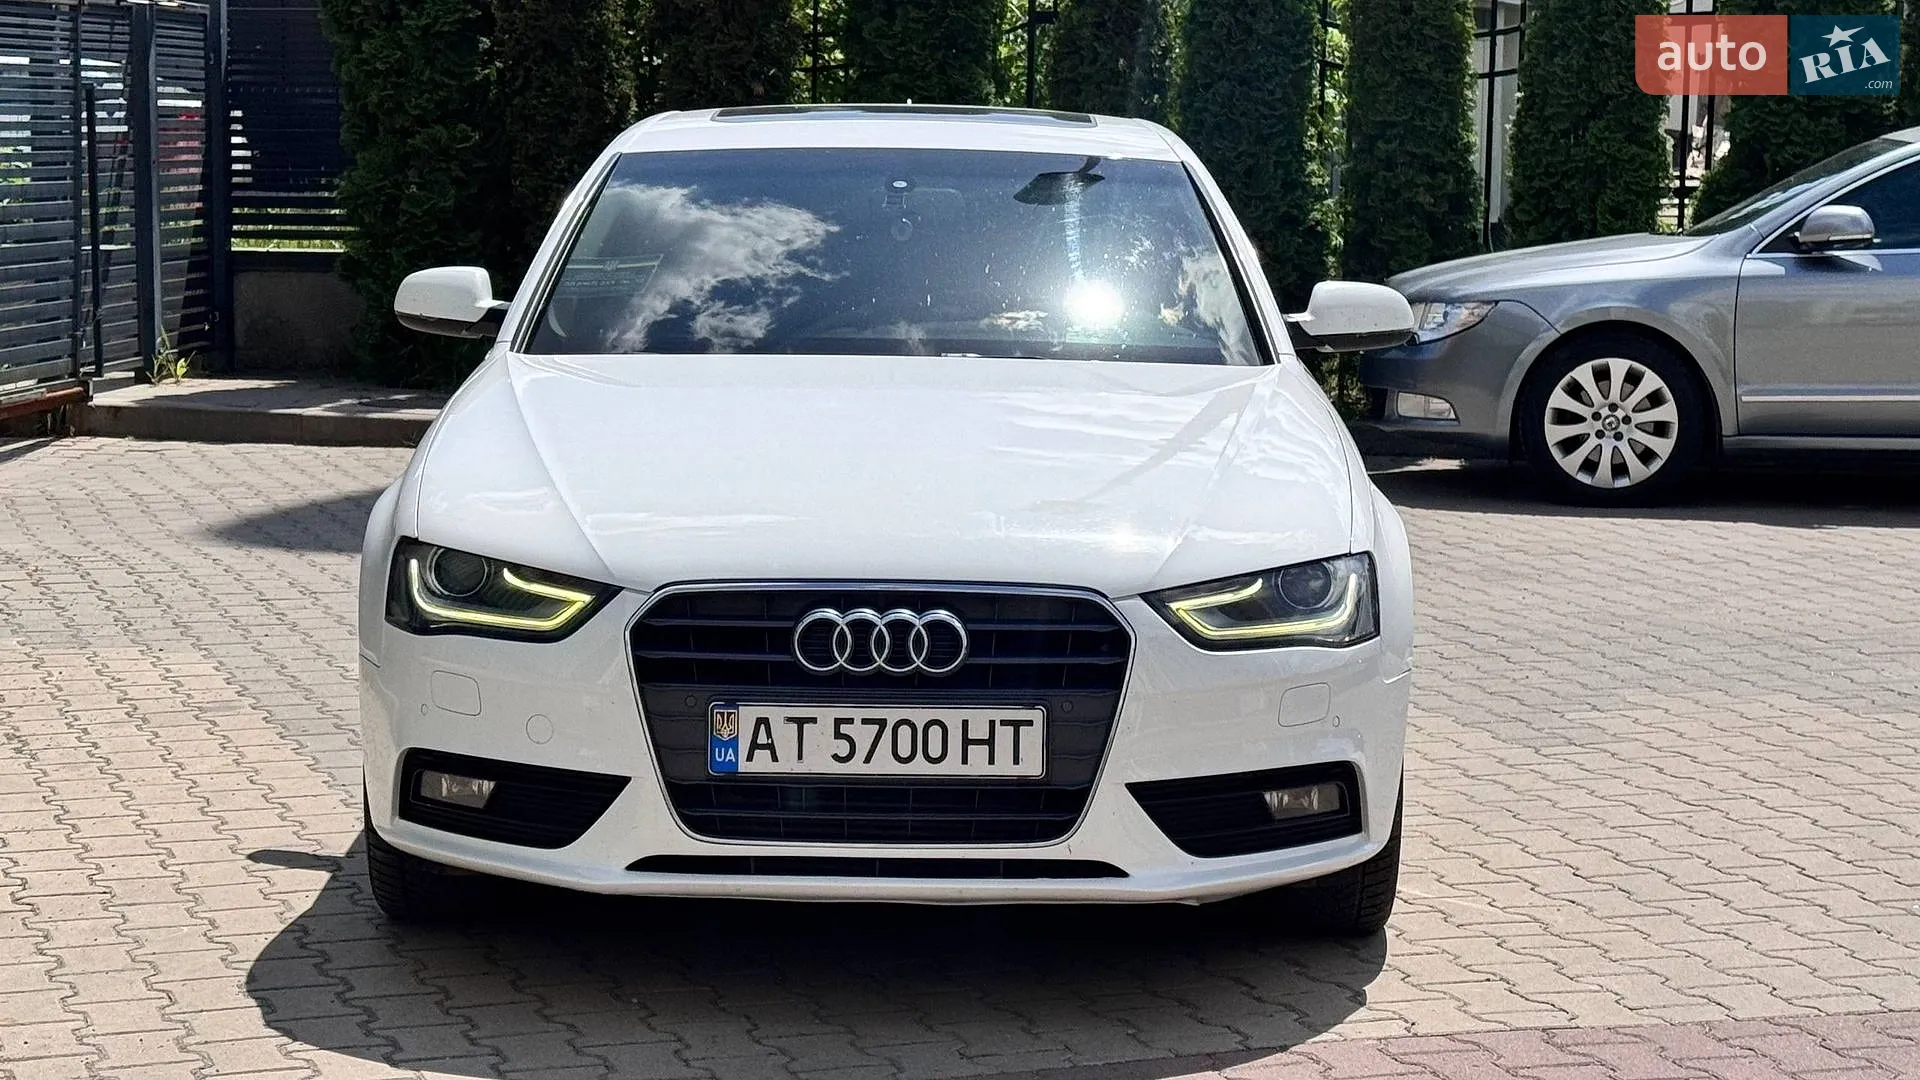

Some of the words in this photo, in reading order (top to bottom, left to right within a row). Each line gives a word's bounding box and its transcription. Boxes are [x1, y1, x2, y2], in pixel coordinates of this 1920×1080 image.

[714, 747, 736, 763] UA
[745, 717, 818, 763] AT
[830, 717, 949, 765] 5700
[961, 719, 1034, 765] HT
